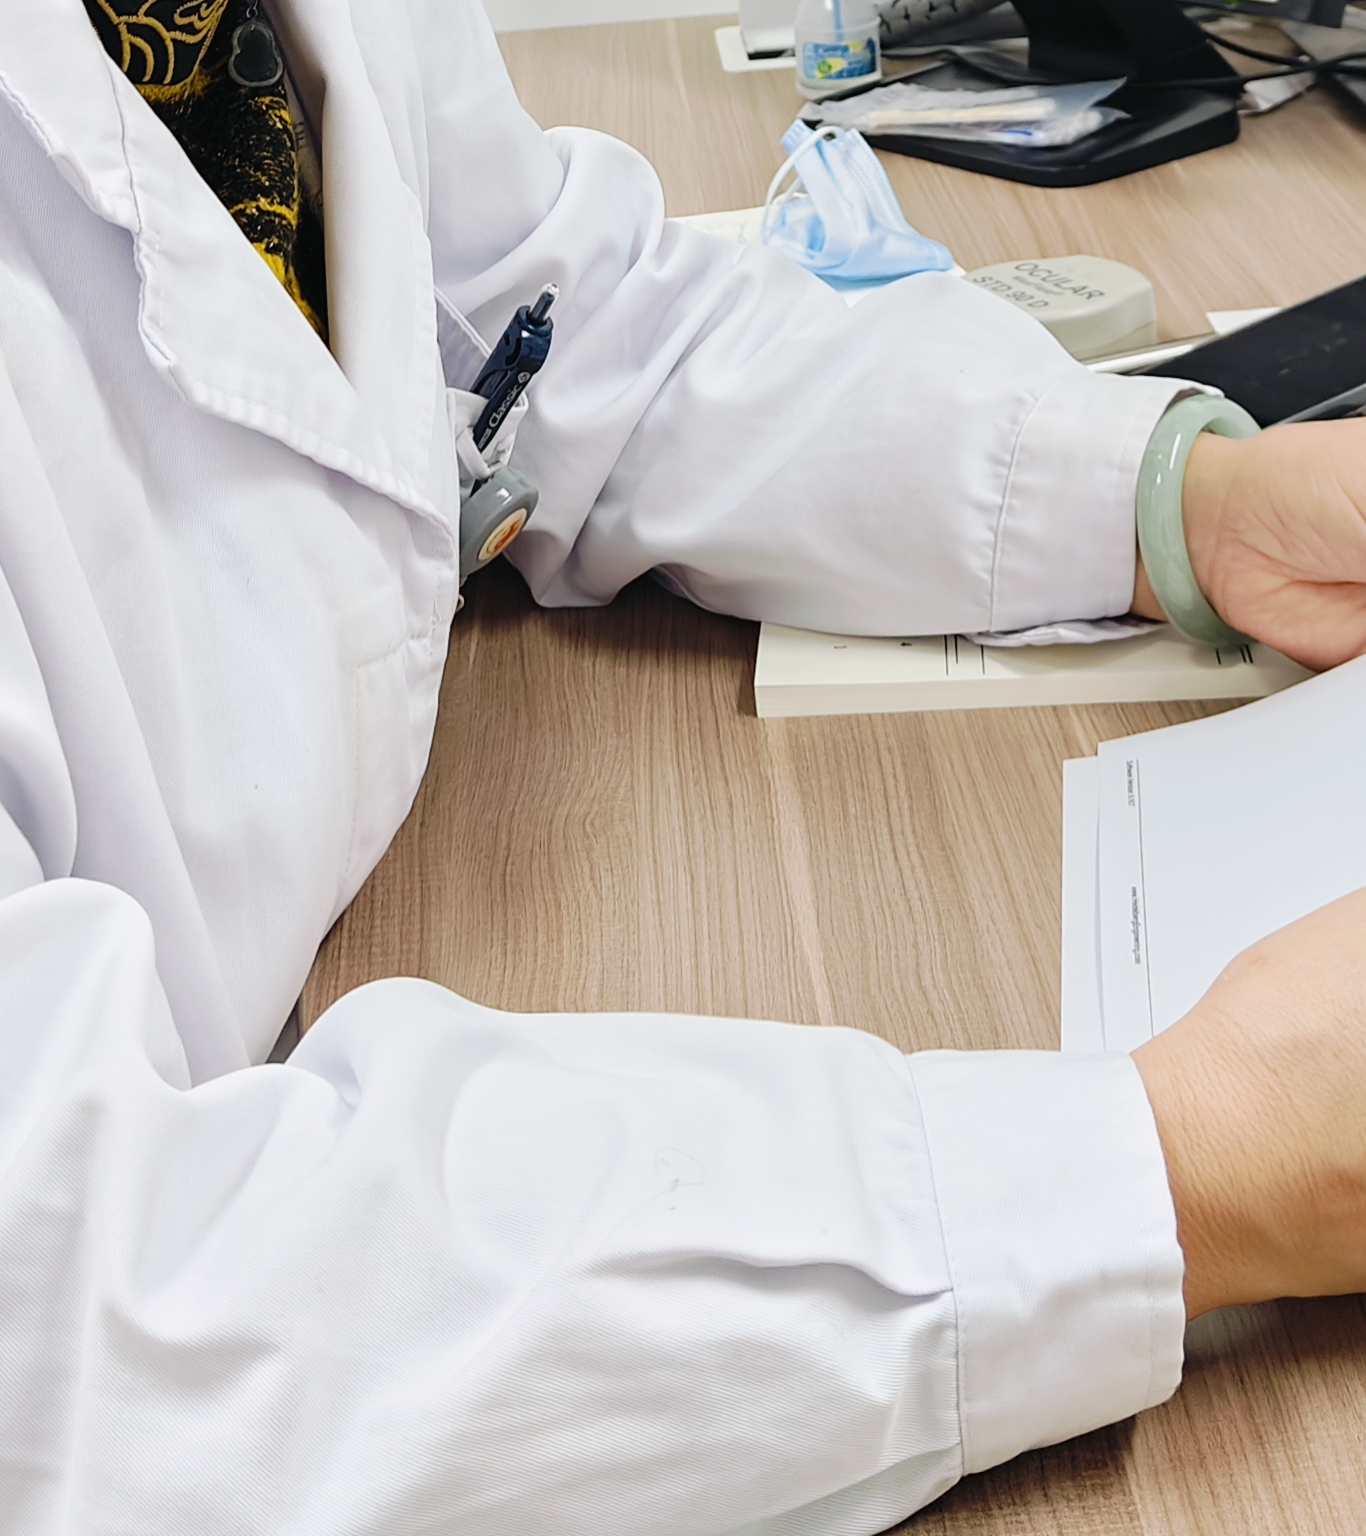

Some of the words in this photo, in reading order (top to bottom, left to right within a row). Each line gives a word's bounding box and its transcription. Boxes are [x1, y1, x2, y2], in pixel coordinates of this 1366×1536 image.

[973, 275, 1012, 293] STD
[1027, 299, 1049, 309] D
[1014, 262, 1105, 300] OCULAR
[488, 384, 523, 428] Classic
